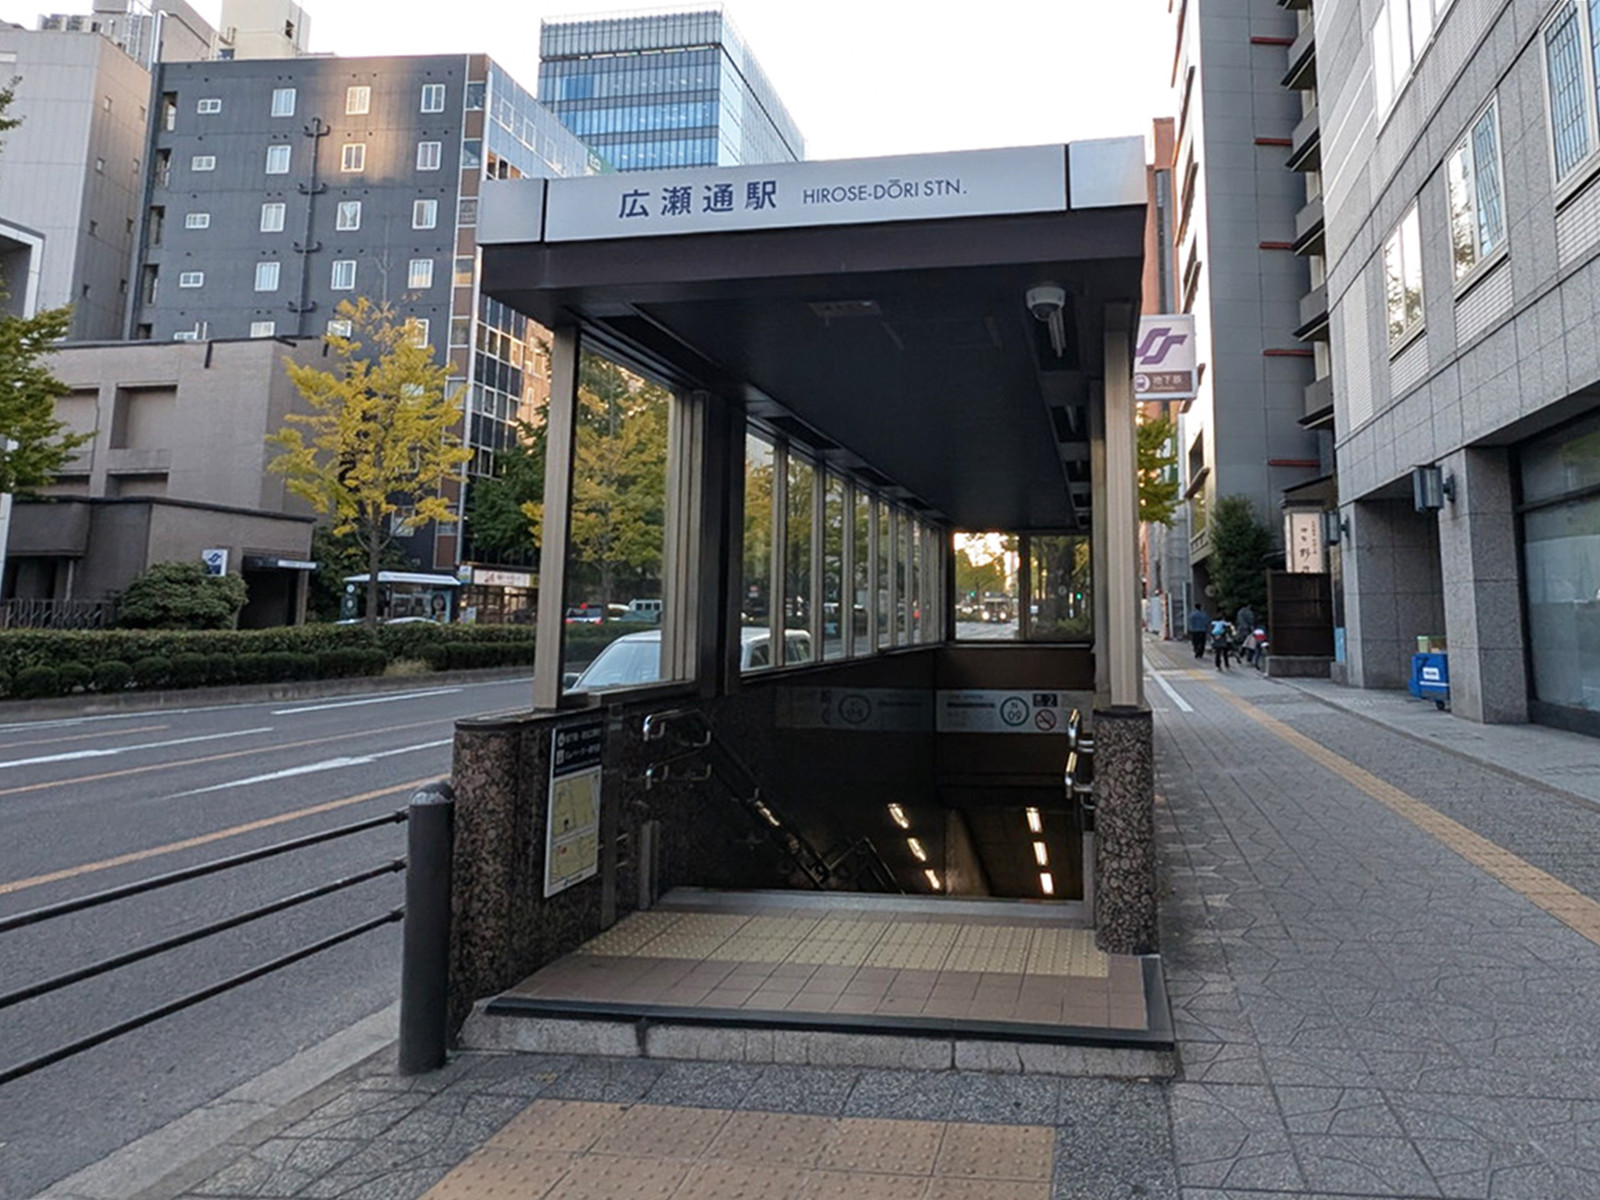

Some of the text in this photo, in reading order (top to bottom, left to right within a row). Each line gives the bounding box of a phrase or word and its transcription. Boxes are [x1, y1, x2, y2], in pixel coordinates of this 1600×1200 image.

[618, 180, 777, 219] 広瀬通駅
[803, 179, 967, 204] HIROSE-DŌRI STN.
